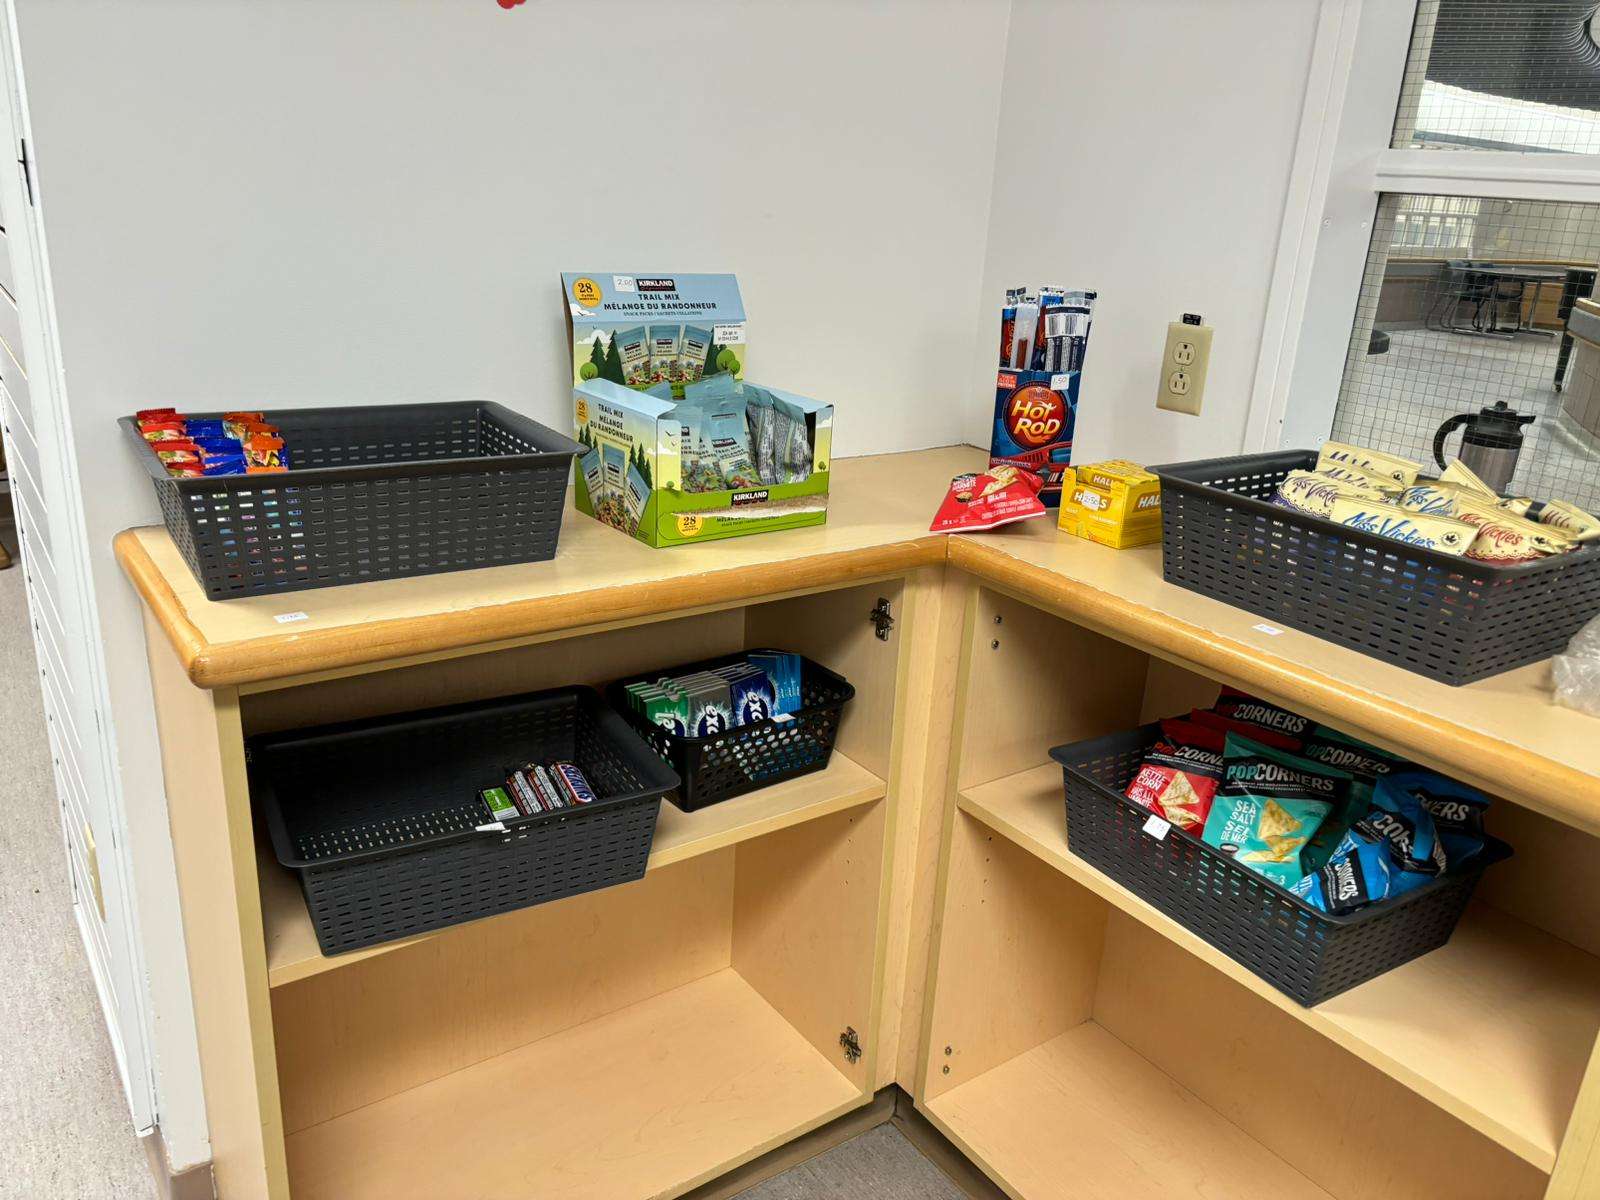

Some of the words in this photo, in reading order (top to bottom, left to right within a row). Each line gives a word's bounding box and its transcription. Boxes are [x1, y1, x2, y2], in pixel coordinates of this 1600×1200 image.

[577, 282, 593, 293] 28
[664, 293, 680, 301] MIX
[604, 302, 644, 310] MÉLANGE
[661, 302, 716, 310] RANDONNEUR
[598, 403, 613, 415] TRAIL
[613, 409, 624, 418] MIX
[590, 420, 598, 429] DU
[598, 423, 634, 442] RANDONNEUR
[733, 491, 768, 501] KIRKLAND
[1138, 495, 1161, 509] HAL
[683, 515, 696, 526] 28
[705, 704, 719, 736] exc
[1136, 776, 1163, 792] CORN
[1226, 762, 1335, 792] POPCORNERS
[1235, 800, 1257, 815] SEA
[1230, 812, 1255, 825] SALT
[1225, 820, 1250, 837] SEL
